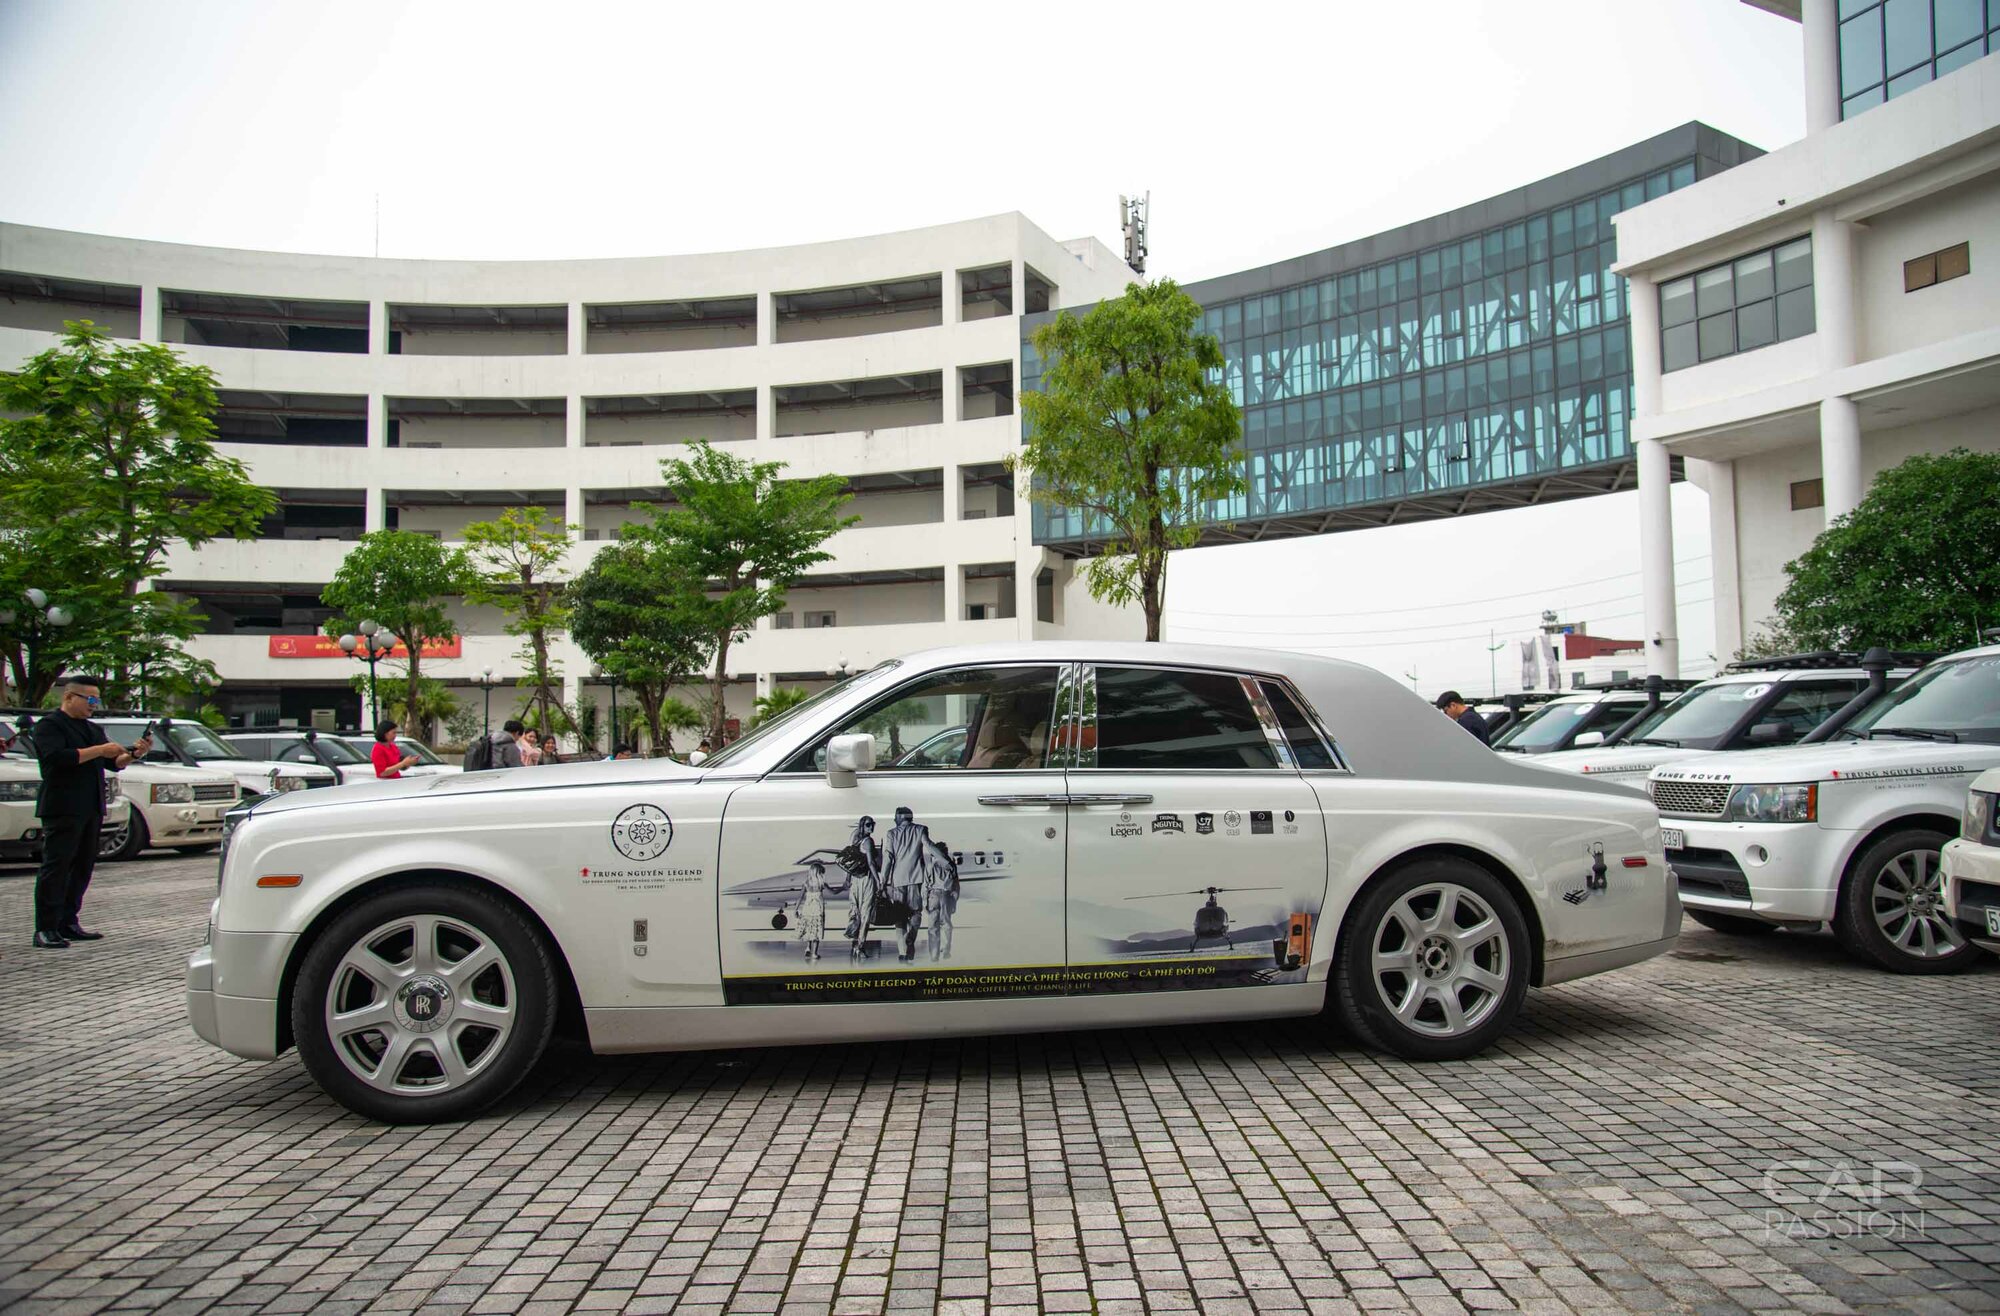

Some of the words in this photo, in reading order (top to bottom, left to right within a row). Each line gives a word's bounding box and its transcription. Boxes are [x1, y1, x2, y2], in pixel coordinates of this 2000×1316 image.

[1845, 770, 1878, 779] TRUNG
[1926, 765, 1965, 774] LEGEND
[1110, 826, 1143, 838] Legend
[592, 870, 624, 878] TRUNG
[627, 868, 664, 877] NGUYÊN
[784, 982, 824, 991] TRUNG
[826, 978, 872, 989] NGUYÊN
[874, 978, 917, 987] LEGEND
[925, 976, 944, 986] TẬP
[979, 973, 1022, 983] CHUYÊN
[1024, 972, 1038, 982] CÀ
[1040, 972, 1060, 981] PHÊ
[1139, 967, 1152, 977] CÀ
[1155, 967, 1174, 977] PHÊ
[942, 986, 974, 994] ENERGY
[976, 985, 1007, 993] COFFEE
